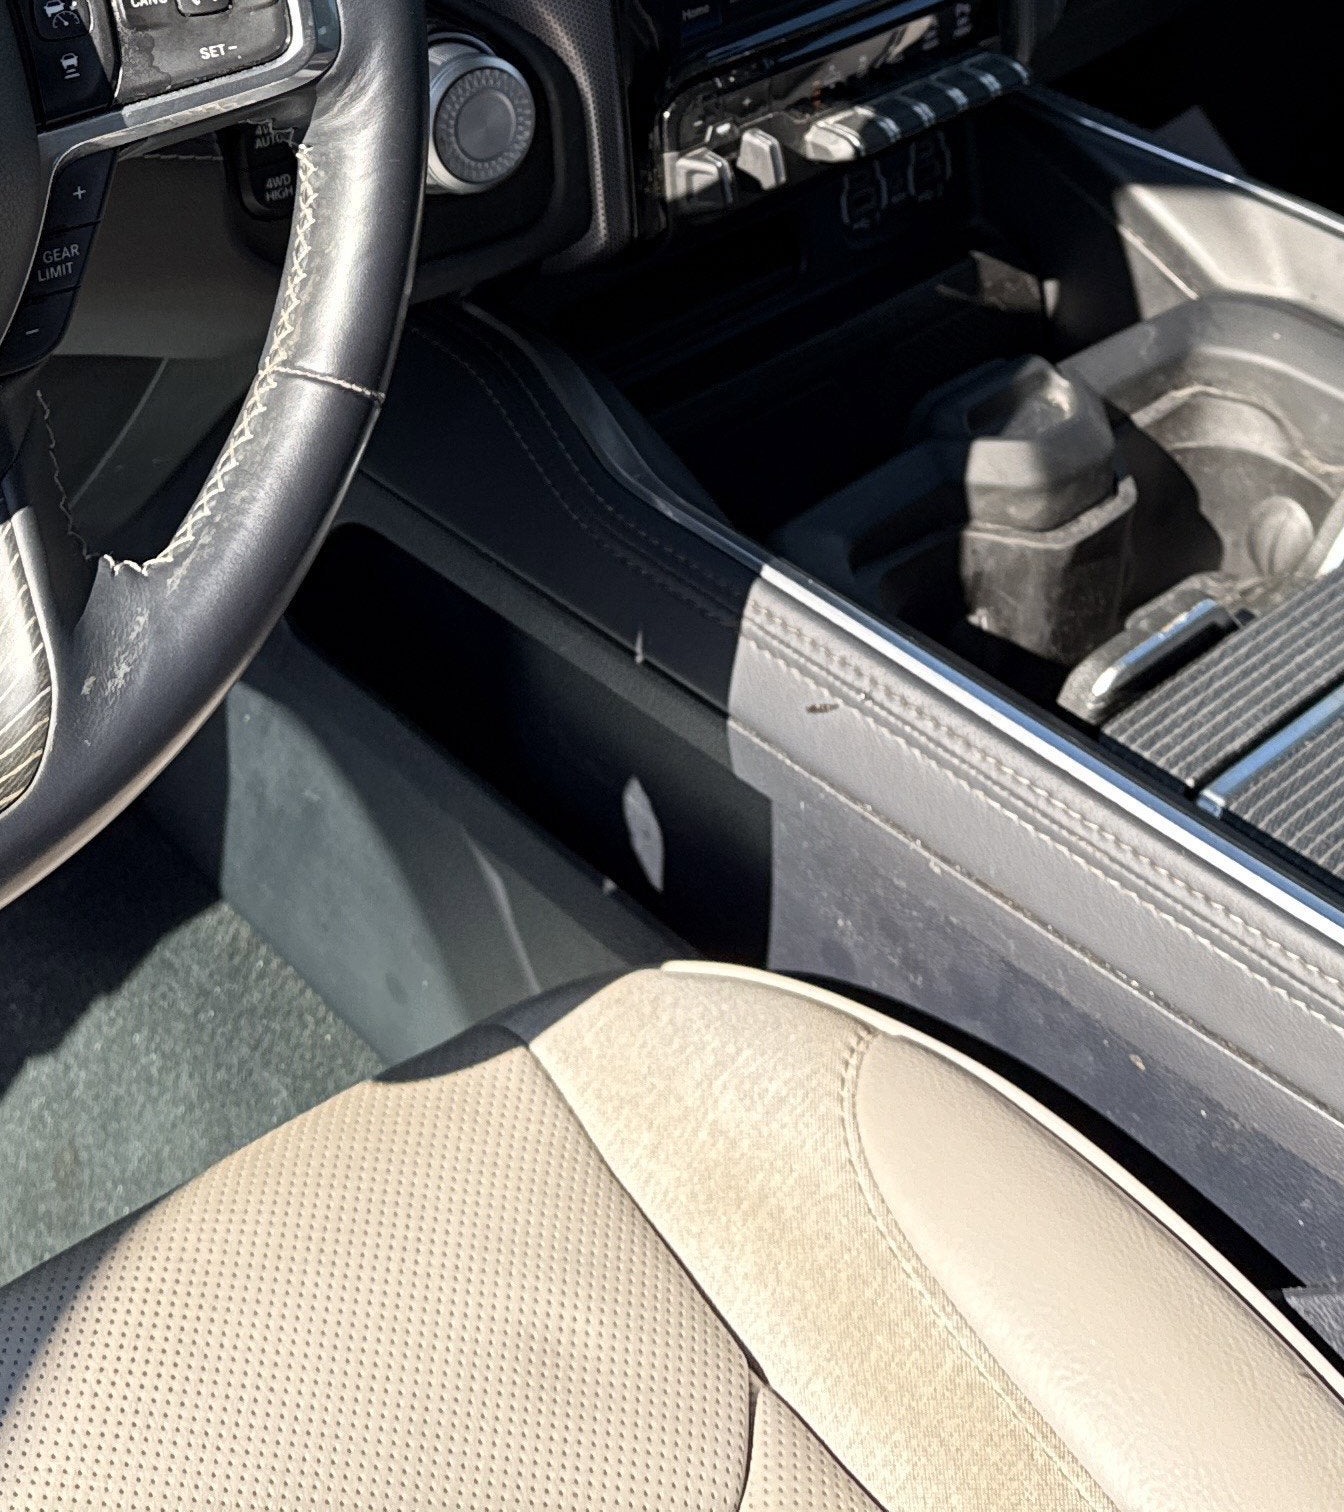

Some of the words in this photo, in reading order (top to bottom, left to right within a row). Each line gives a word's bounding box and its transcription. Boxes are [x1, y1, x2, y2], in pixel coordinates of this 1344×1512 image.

[265, 173, 292, 190] 4WD
[265, 185, 294, 202] HIGH
[41, 243, 80, 265] GEAR
[36, 261, 74, 283] LIMIT
